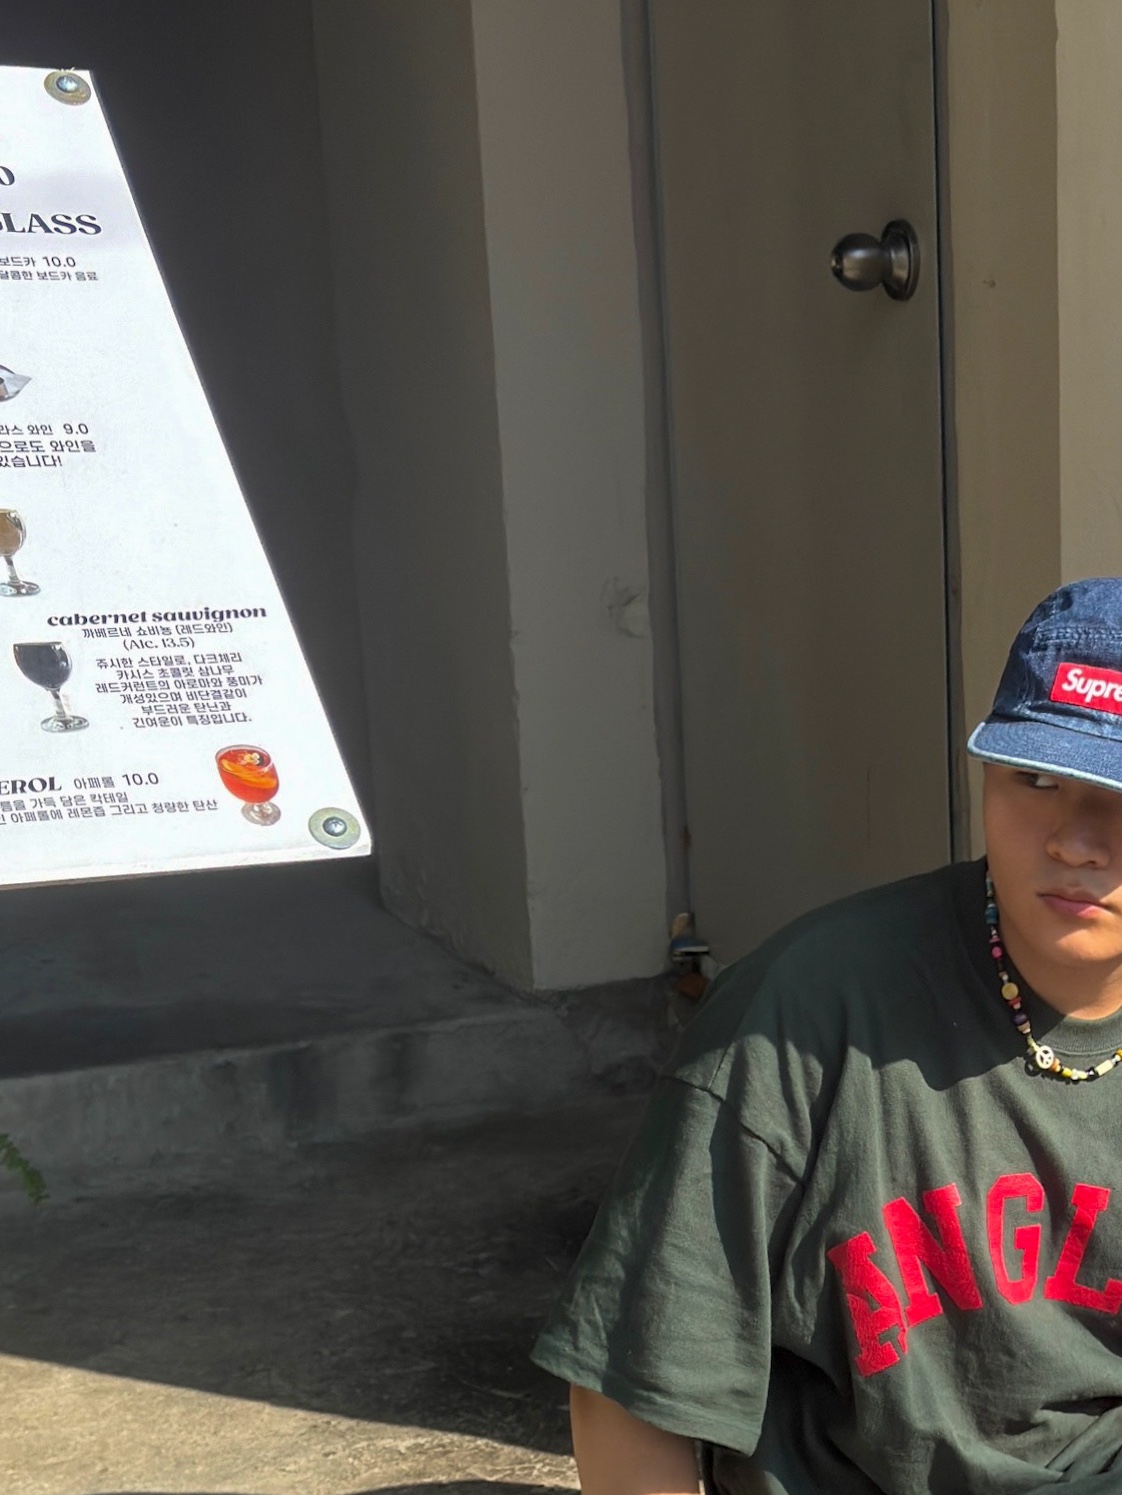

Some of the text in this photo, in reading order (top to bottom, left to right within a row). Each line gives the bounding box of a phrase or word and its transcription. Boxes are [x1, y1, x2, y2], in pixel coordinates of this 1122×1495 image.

[0, 212, 102, 235] LASS
[0, 256, 76, 268] 보드카 10.0
[37, 271, 72, 281] 보드카
[75, 271, 99, 281] 음료
[27, 424, 54, 435] 와인
[63, 423, 89, 435] 9.0
[49, 440, 96, 453] 와인을
[47, 607, 267, 627] cabernet sauvignon
[82, 626, 132, 639] 까베르네
[175, 622, 233, 635] (레드와인)
[123, 636, 195, 651] (Alc. 13.5)
[96, 657, 133, 669] 쥬시한
[193, 652, 242, 665] 다크체리
[116, 669, 155, 680] 카시스
[198, 664, 234, 676] 삼나무
[95, 674, 263, 693] 레드커런트의 아로마와 풍미가
[120, 692, 182, 704] 개성있으며
[141, 701, 231, 715] 부드러운 탄닌과
[73, 776, 115, 790] 아페롤
[122, 772, 159, 787] 10.0
[30, 797, 57, 809] 가득
[60, 794, 87, 807] 담은
[90, 791, 129, 804] 칵테일
[10, 808, 63, 824] 아페롤에
[109, 803, 148, 816] 그리고
[152, 801, 190, 814] 청량한
[192, 799, 219, 811] 탄산
